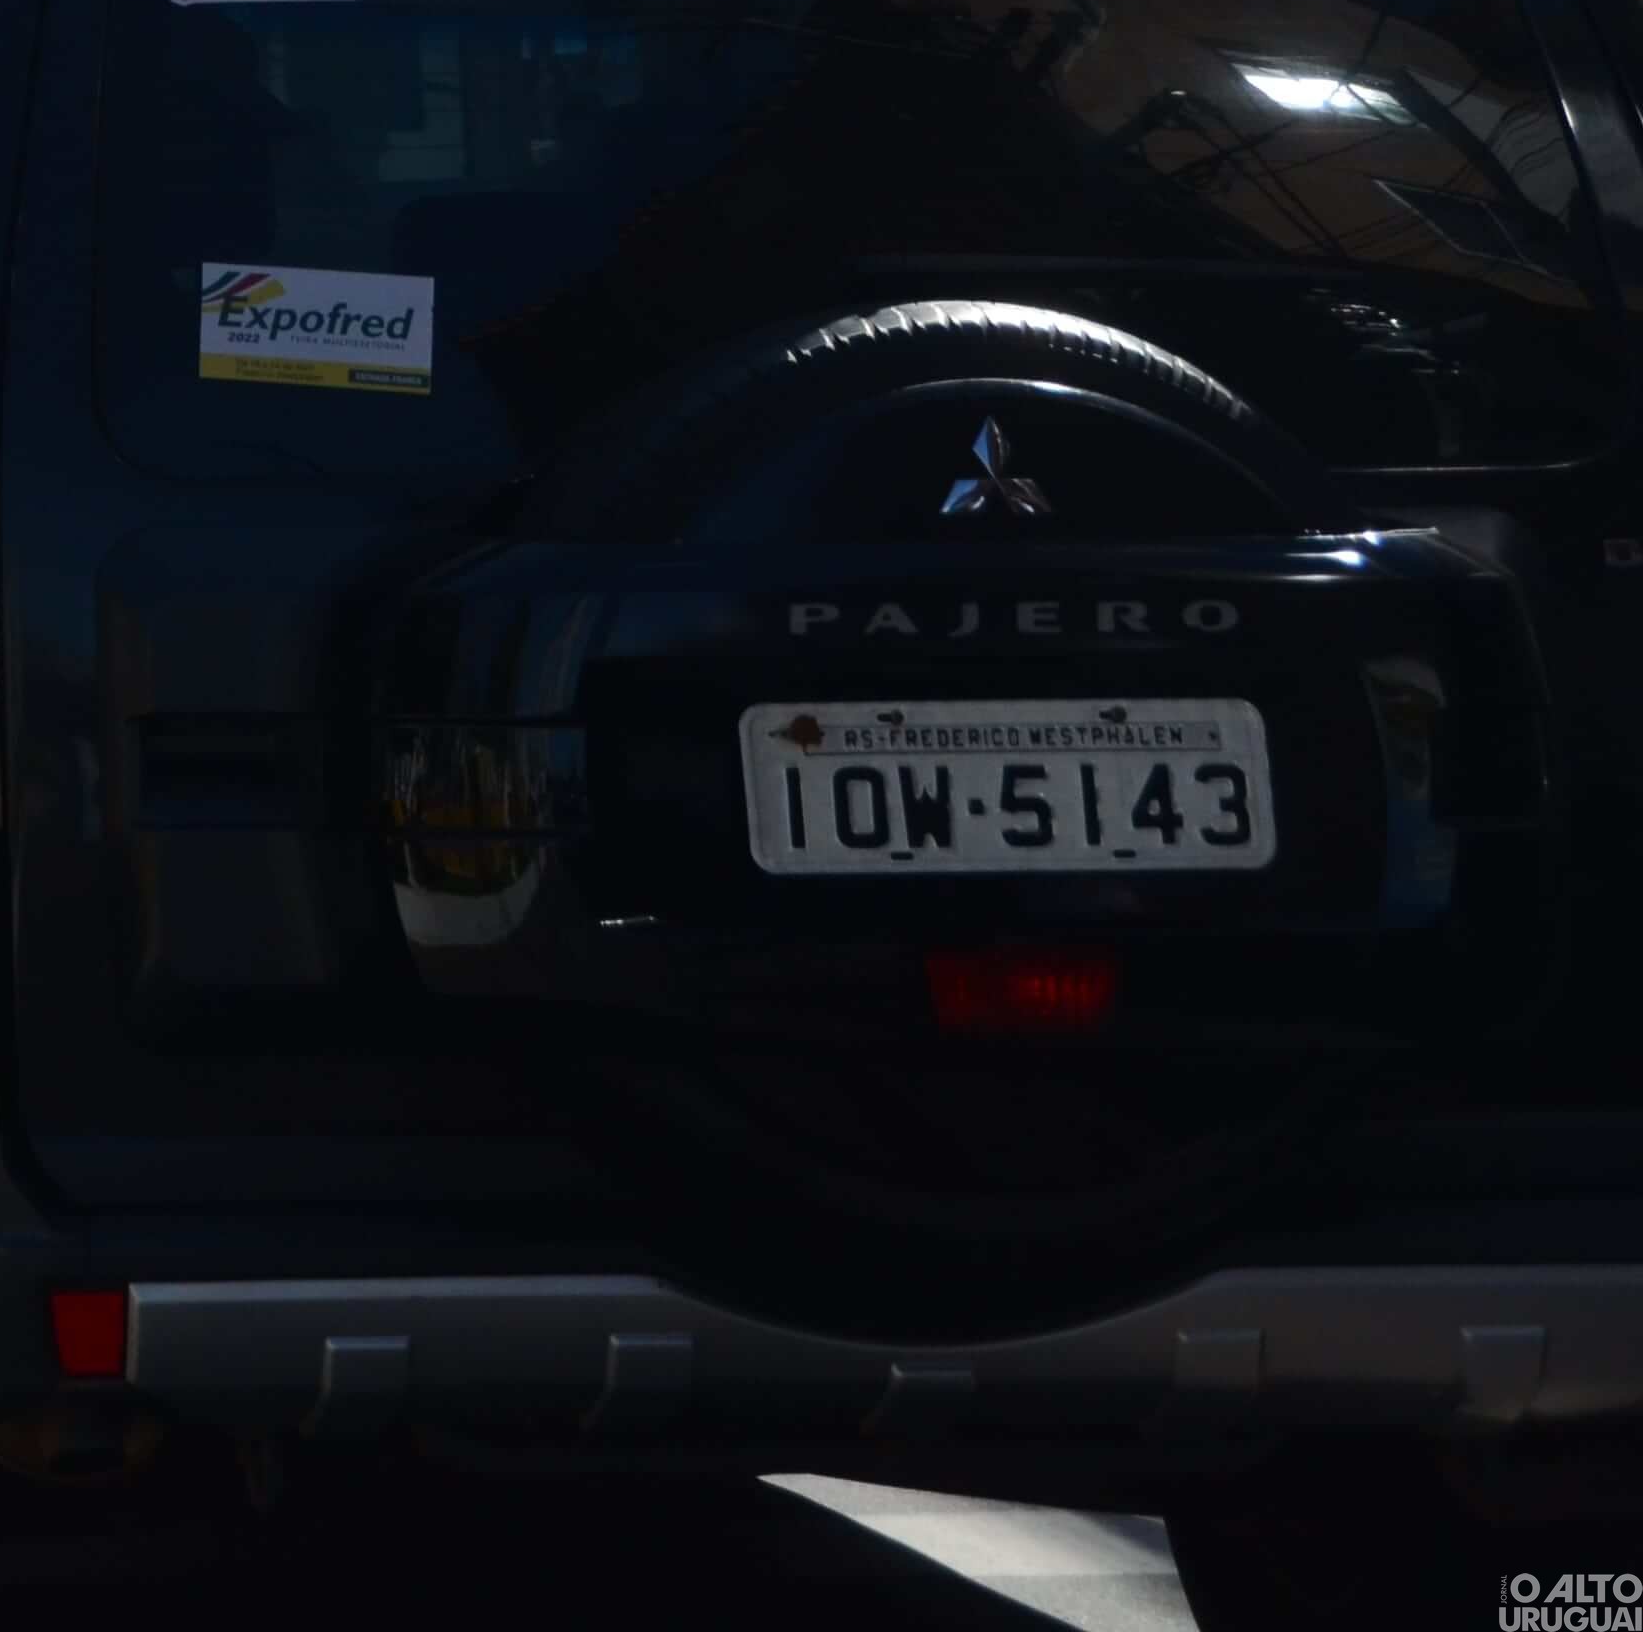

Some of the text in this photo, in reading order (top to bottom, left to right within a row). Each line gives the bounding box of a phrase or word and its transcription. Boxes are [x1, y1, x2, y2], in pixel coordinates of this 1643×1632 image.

[217, 293, 414, 348] Expofred
[227, 330, 261, 345] 2022
[788, 599, 1240, 638] PAJERO
[1029, 724, 1184, 747] WESTPHALEN
